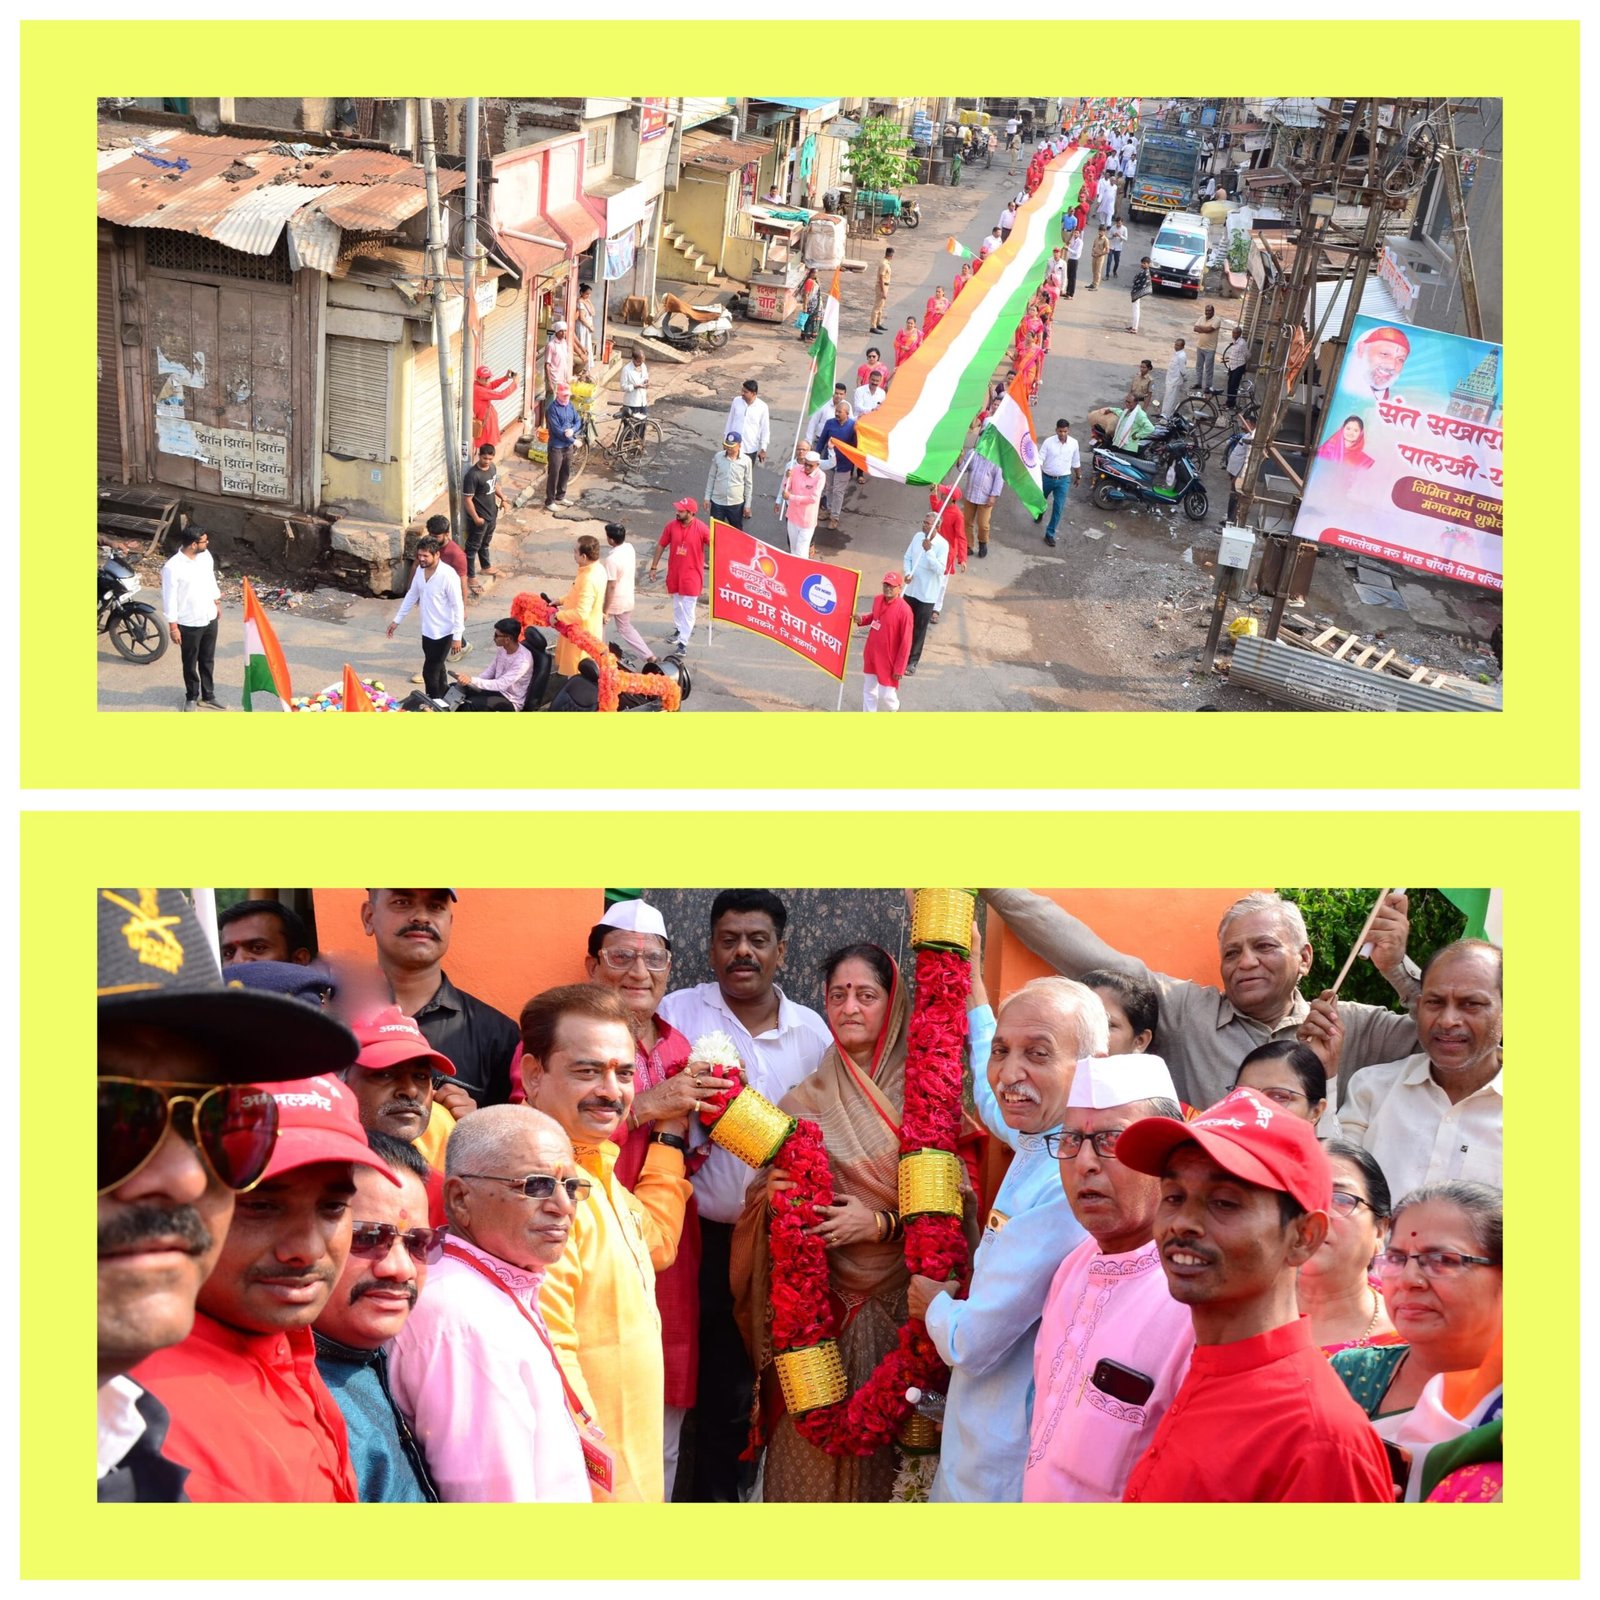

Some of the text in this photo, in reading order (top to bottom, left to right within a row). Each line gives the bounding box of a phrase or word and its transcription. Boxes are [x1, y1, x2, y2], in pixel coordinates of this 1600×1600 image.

[759, 297, 776, 309] चाट
[1379, 398, 1422, 431] संत
[223, 434, 252, 450] झिरॉन
[256, 439, 286, 455] झिरॉन
[224, 455, 253, 470] झिरॉन
[255, 459, 285, 475] झिरॉन
[223, 476, 252, 492] झिरॉन
[256, 480, 286, 496] झिरॉन
[1411, 479, 1451, 501] निमित्त
[1453, 492, 1476, 507] सर्व
[1421, 498, 1472, 521] मंगलमय
[1337, 534, 1383, 554] नगरसेवक
[1402, 550, 1425, 565] भाऊ
[1456, 564, 1477, 581] मित्र
[719, 583, 754, 610] मंगळ
[757, 600, 777, 622] ग्रह
[779, 605, 807, 635] सेवा
[810, 621, 843, 655] संस्था
